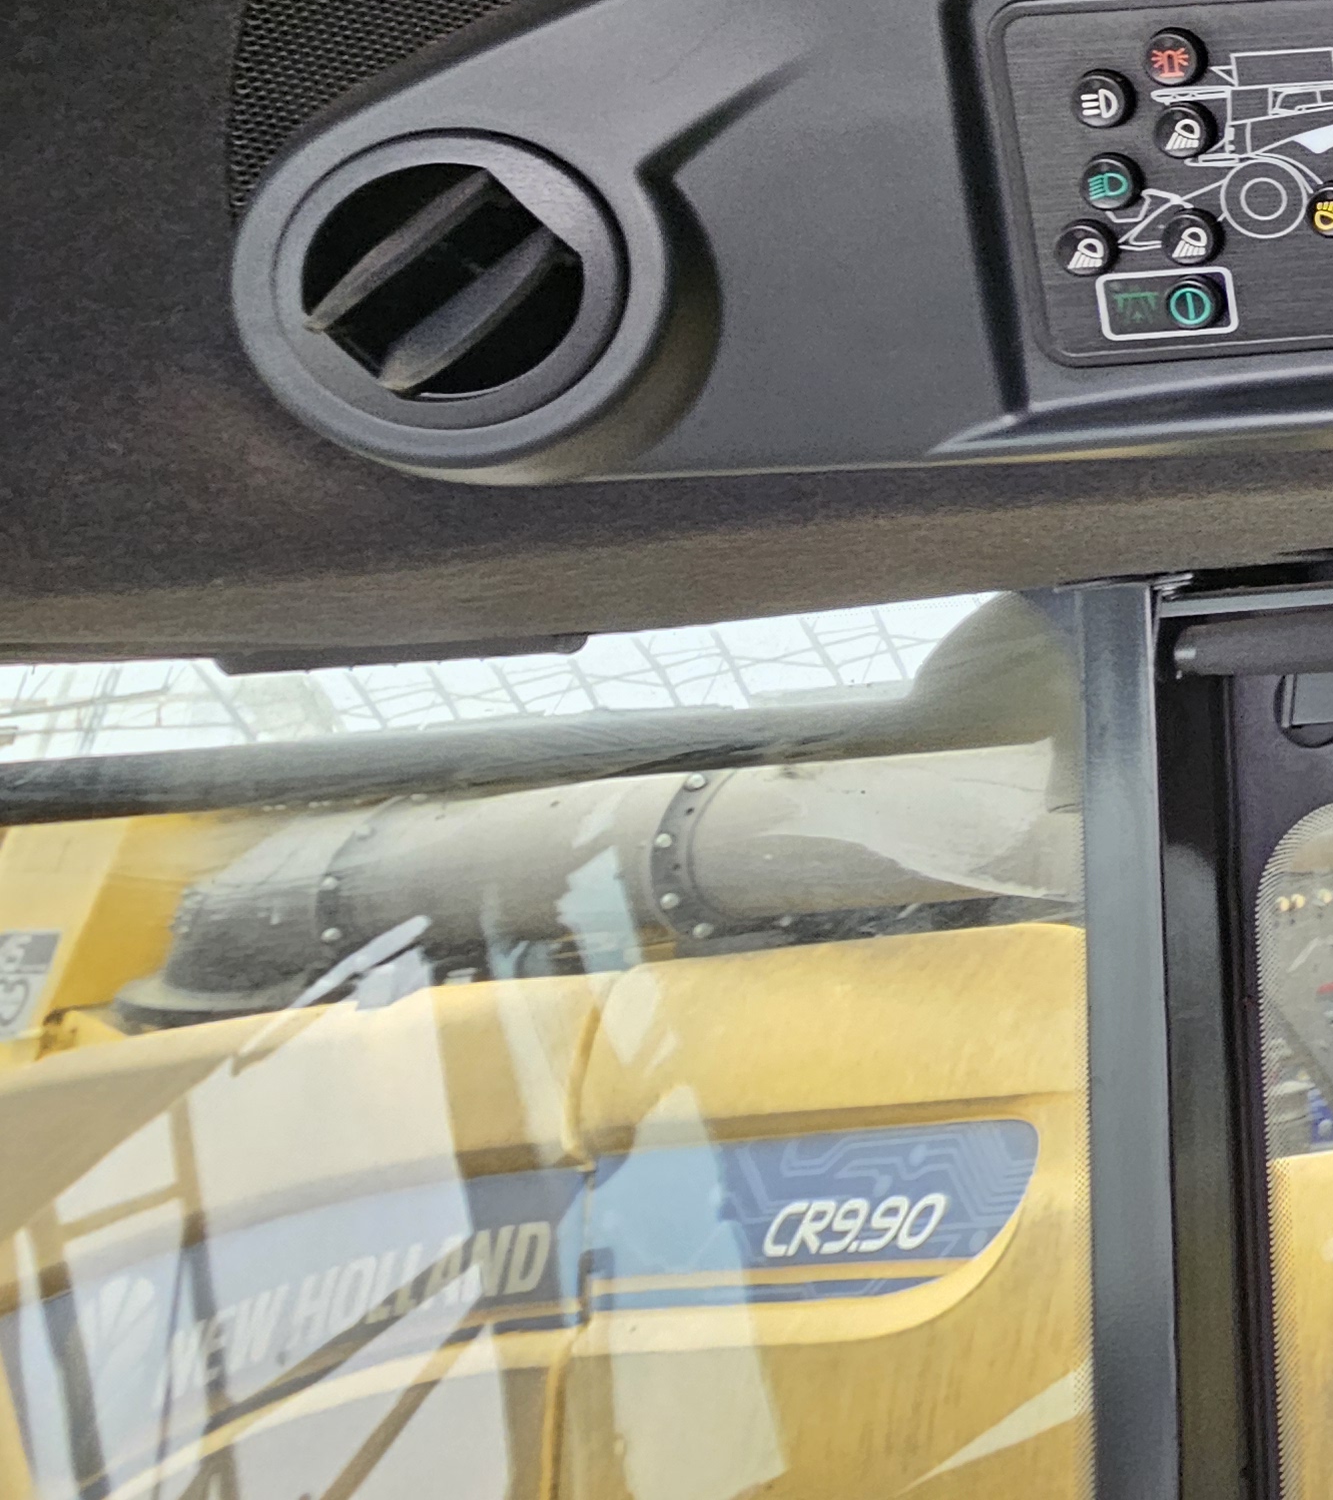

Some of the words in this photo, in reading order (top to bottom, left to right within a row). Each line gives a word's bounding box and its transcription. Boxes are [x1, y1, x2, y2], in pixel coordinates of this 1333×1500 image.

[763, 1192, 948, 1257] CR9.90
[153, 1283, 290, 1410] NEW
[289, 1220, 552, 1350] HOLLAND
